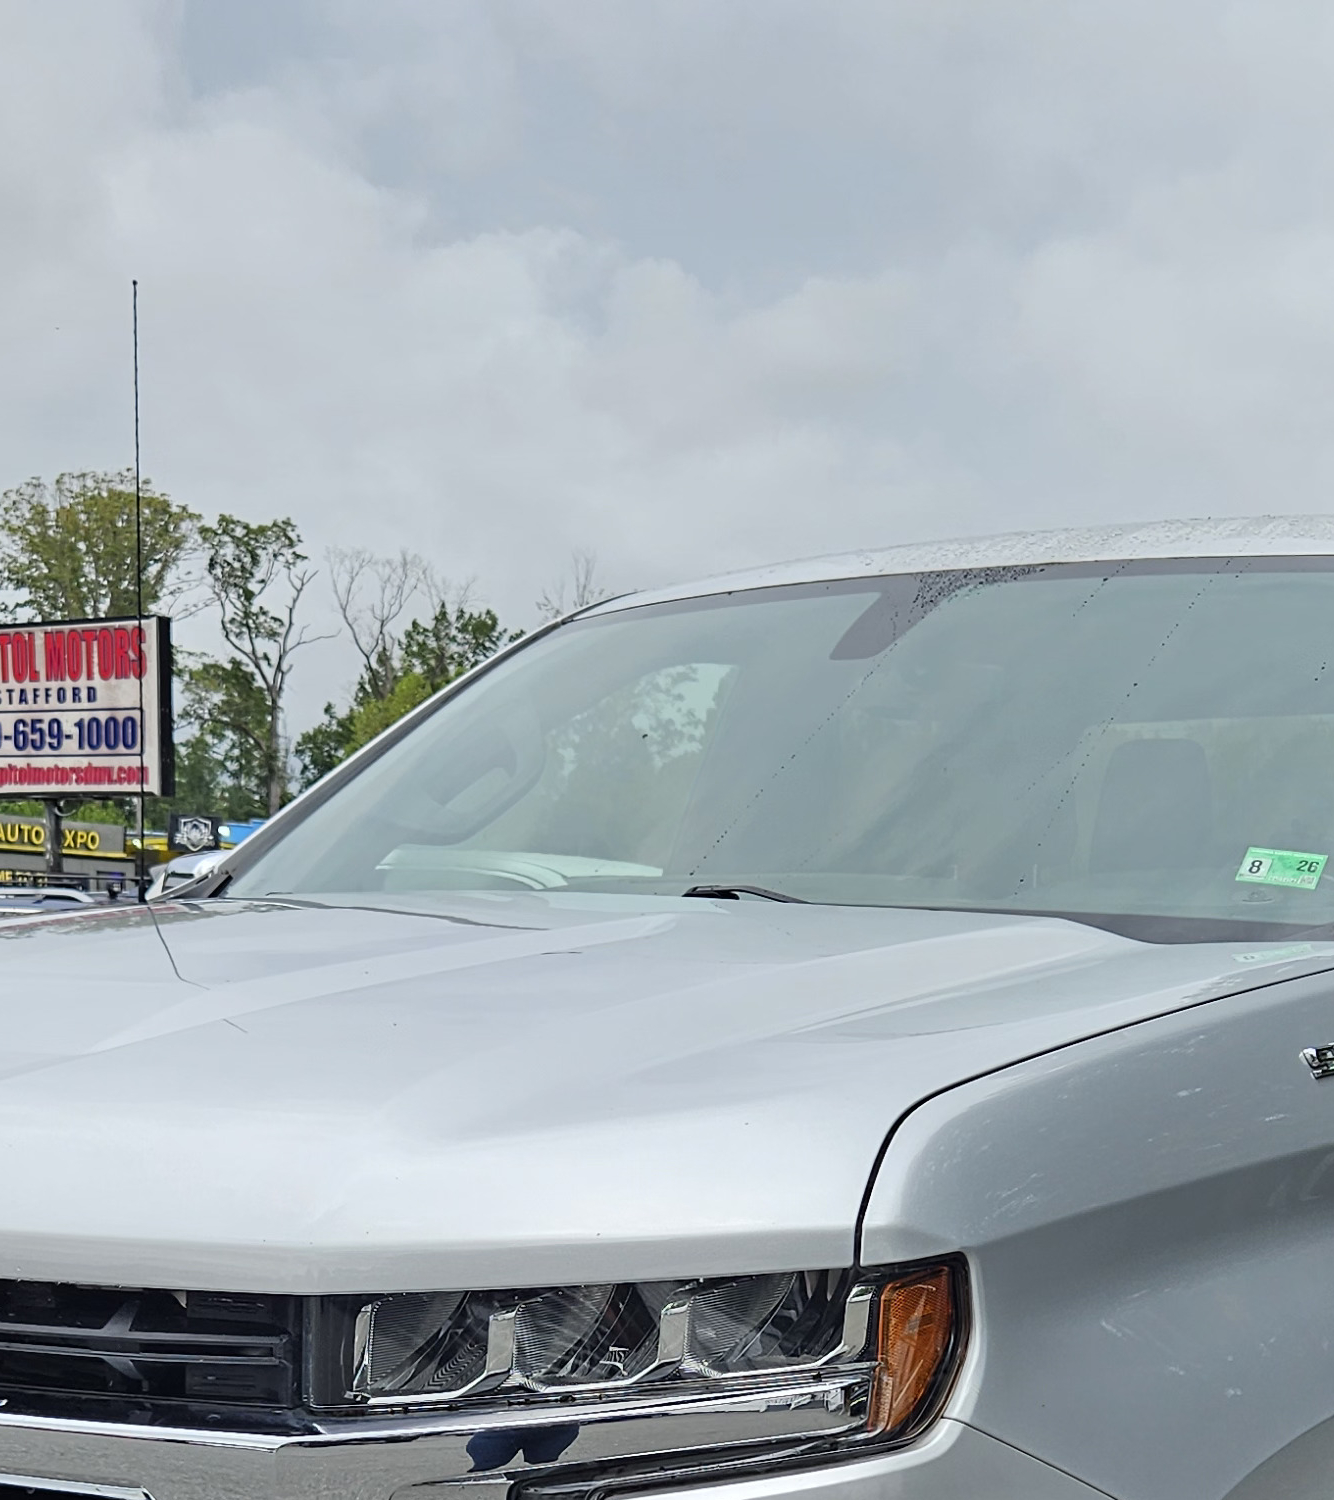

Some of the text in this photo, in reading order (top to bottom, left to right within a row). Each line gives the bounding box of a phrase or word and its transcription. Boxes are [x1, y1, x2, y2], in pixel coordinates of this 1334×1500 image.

[44, 626, 148, 682] MOTORS
[63, 829, 100, 850] XPO
[1247, 859, 1321, 875] 8 26
